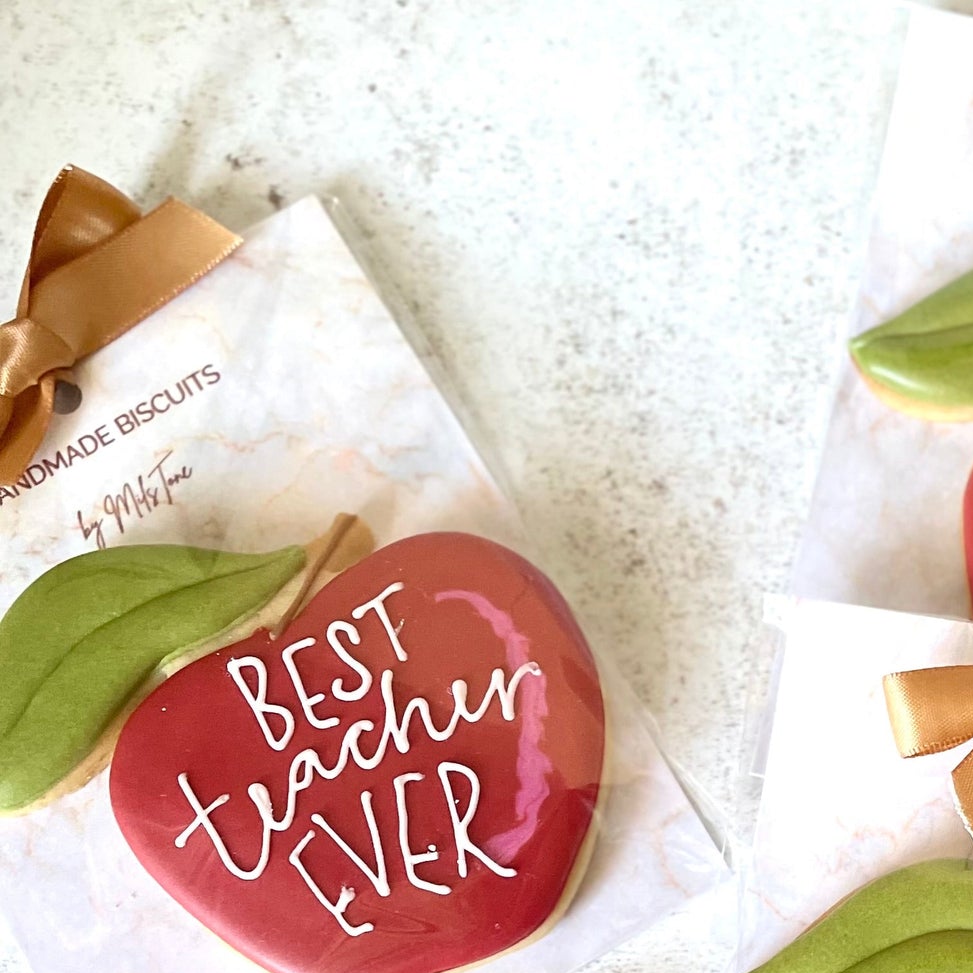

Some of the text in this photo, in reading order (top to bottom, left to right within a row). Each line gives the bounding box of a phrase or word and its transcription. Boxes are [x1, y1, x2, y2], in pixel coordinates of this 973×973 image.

[0, 363, 221, 506] ANDMADE BISCUITS
[77, 510, 106, 549] by
[226, 582, 409, 752] BEST
[174, 661, 542, 881] teacher
[289, 761, 518, 937] EVER
